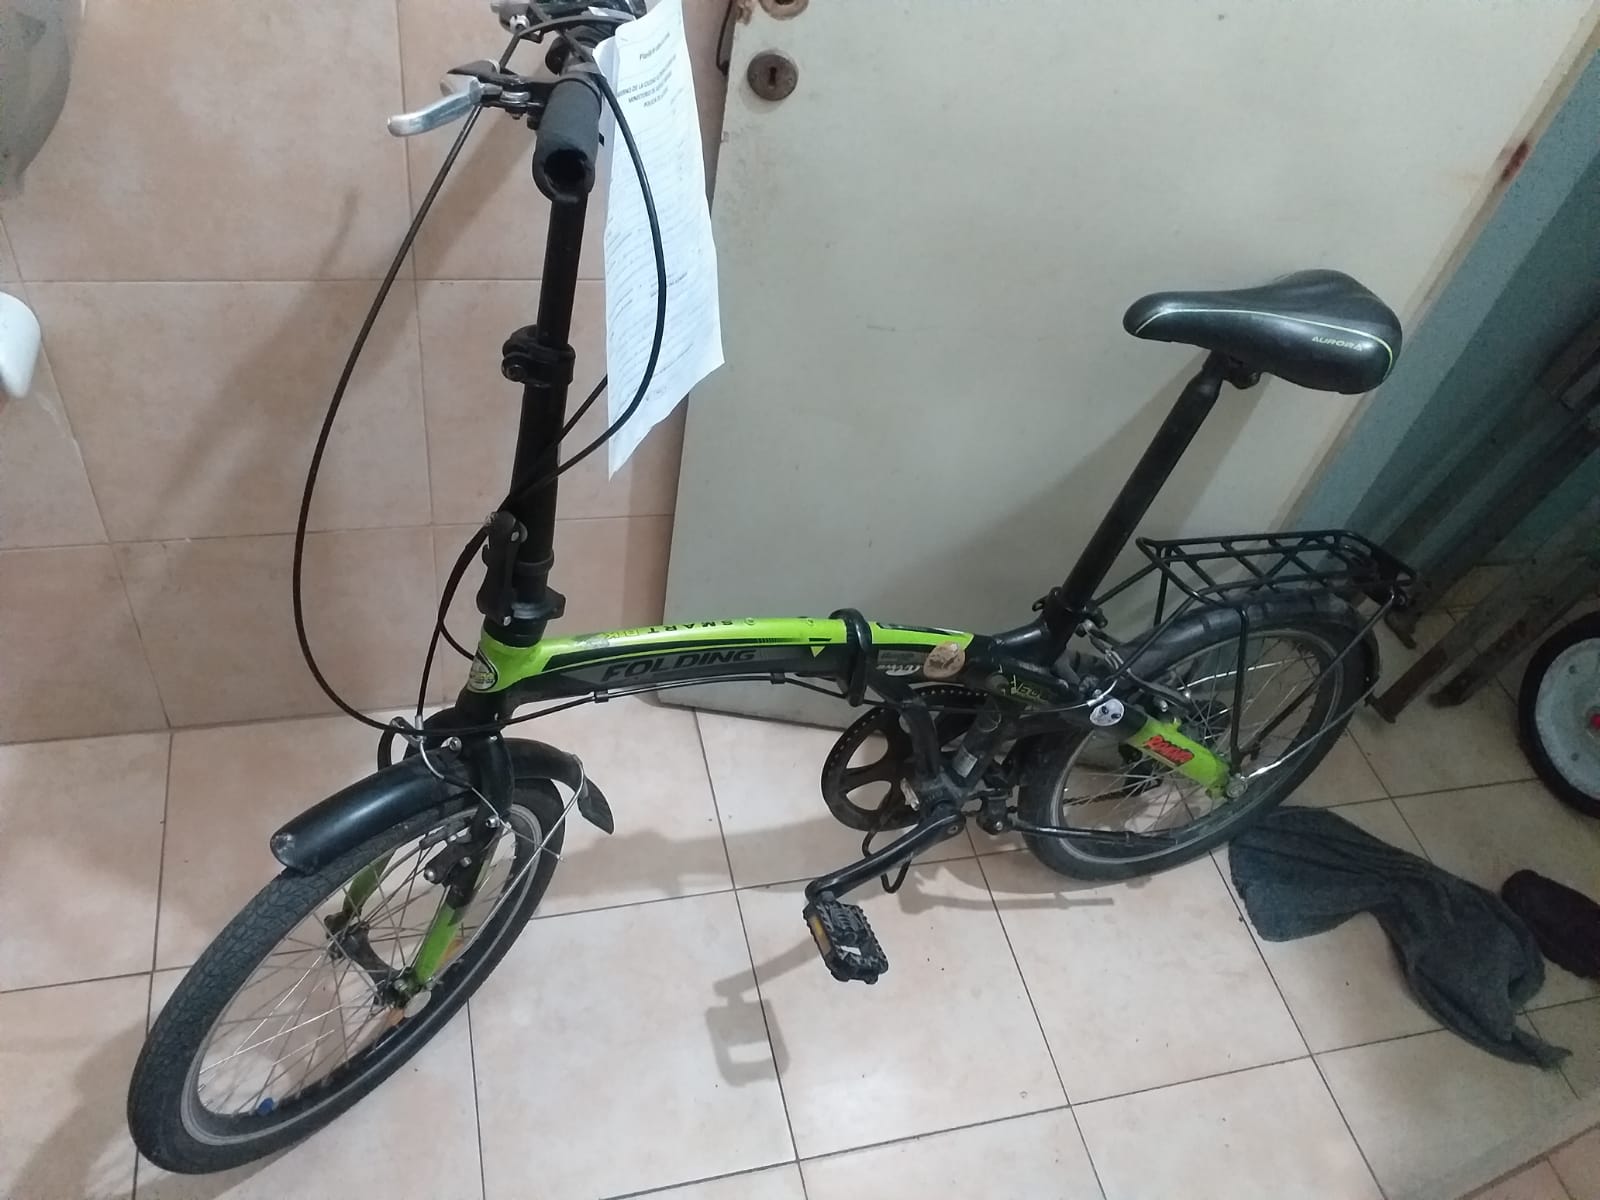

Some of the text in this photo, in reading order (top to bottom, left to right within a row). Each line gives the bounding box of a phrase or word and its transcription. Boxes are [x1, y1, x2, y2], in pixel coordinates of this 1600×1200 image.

[1312, 336, 1363, 351] AURORA
[600, 619, 733, 640] SMART BIK
[602, 649, 757, 681] FOLDING
